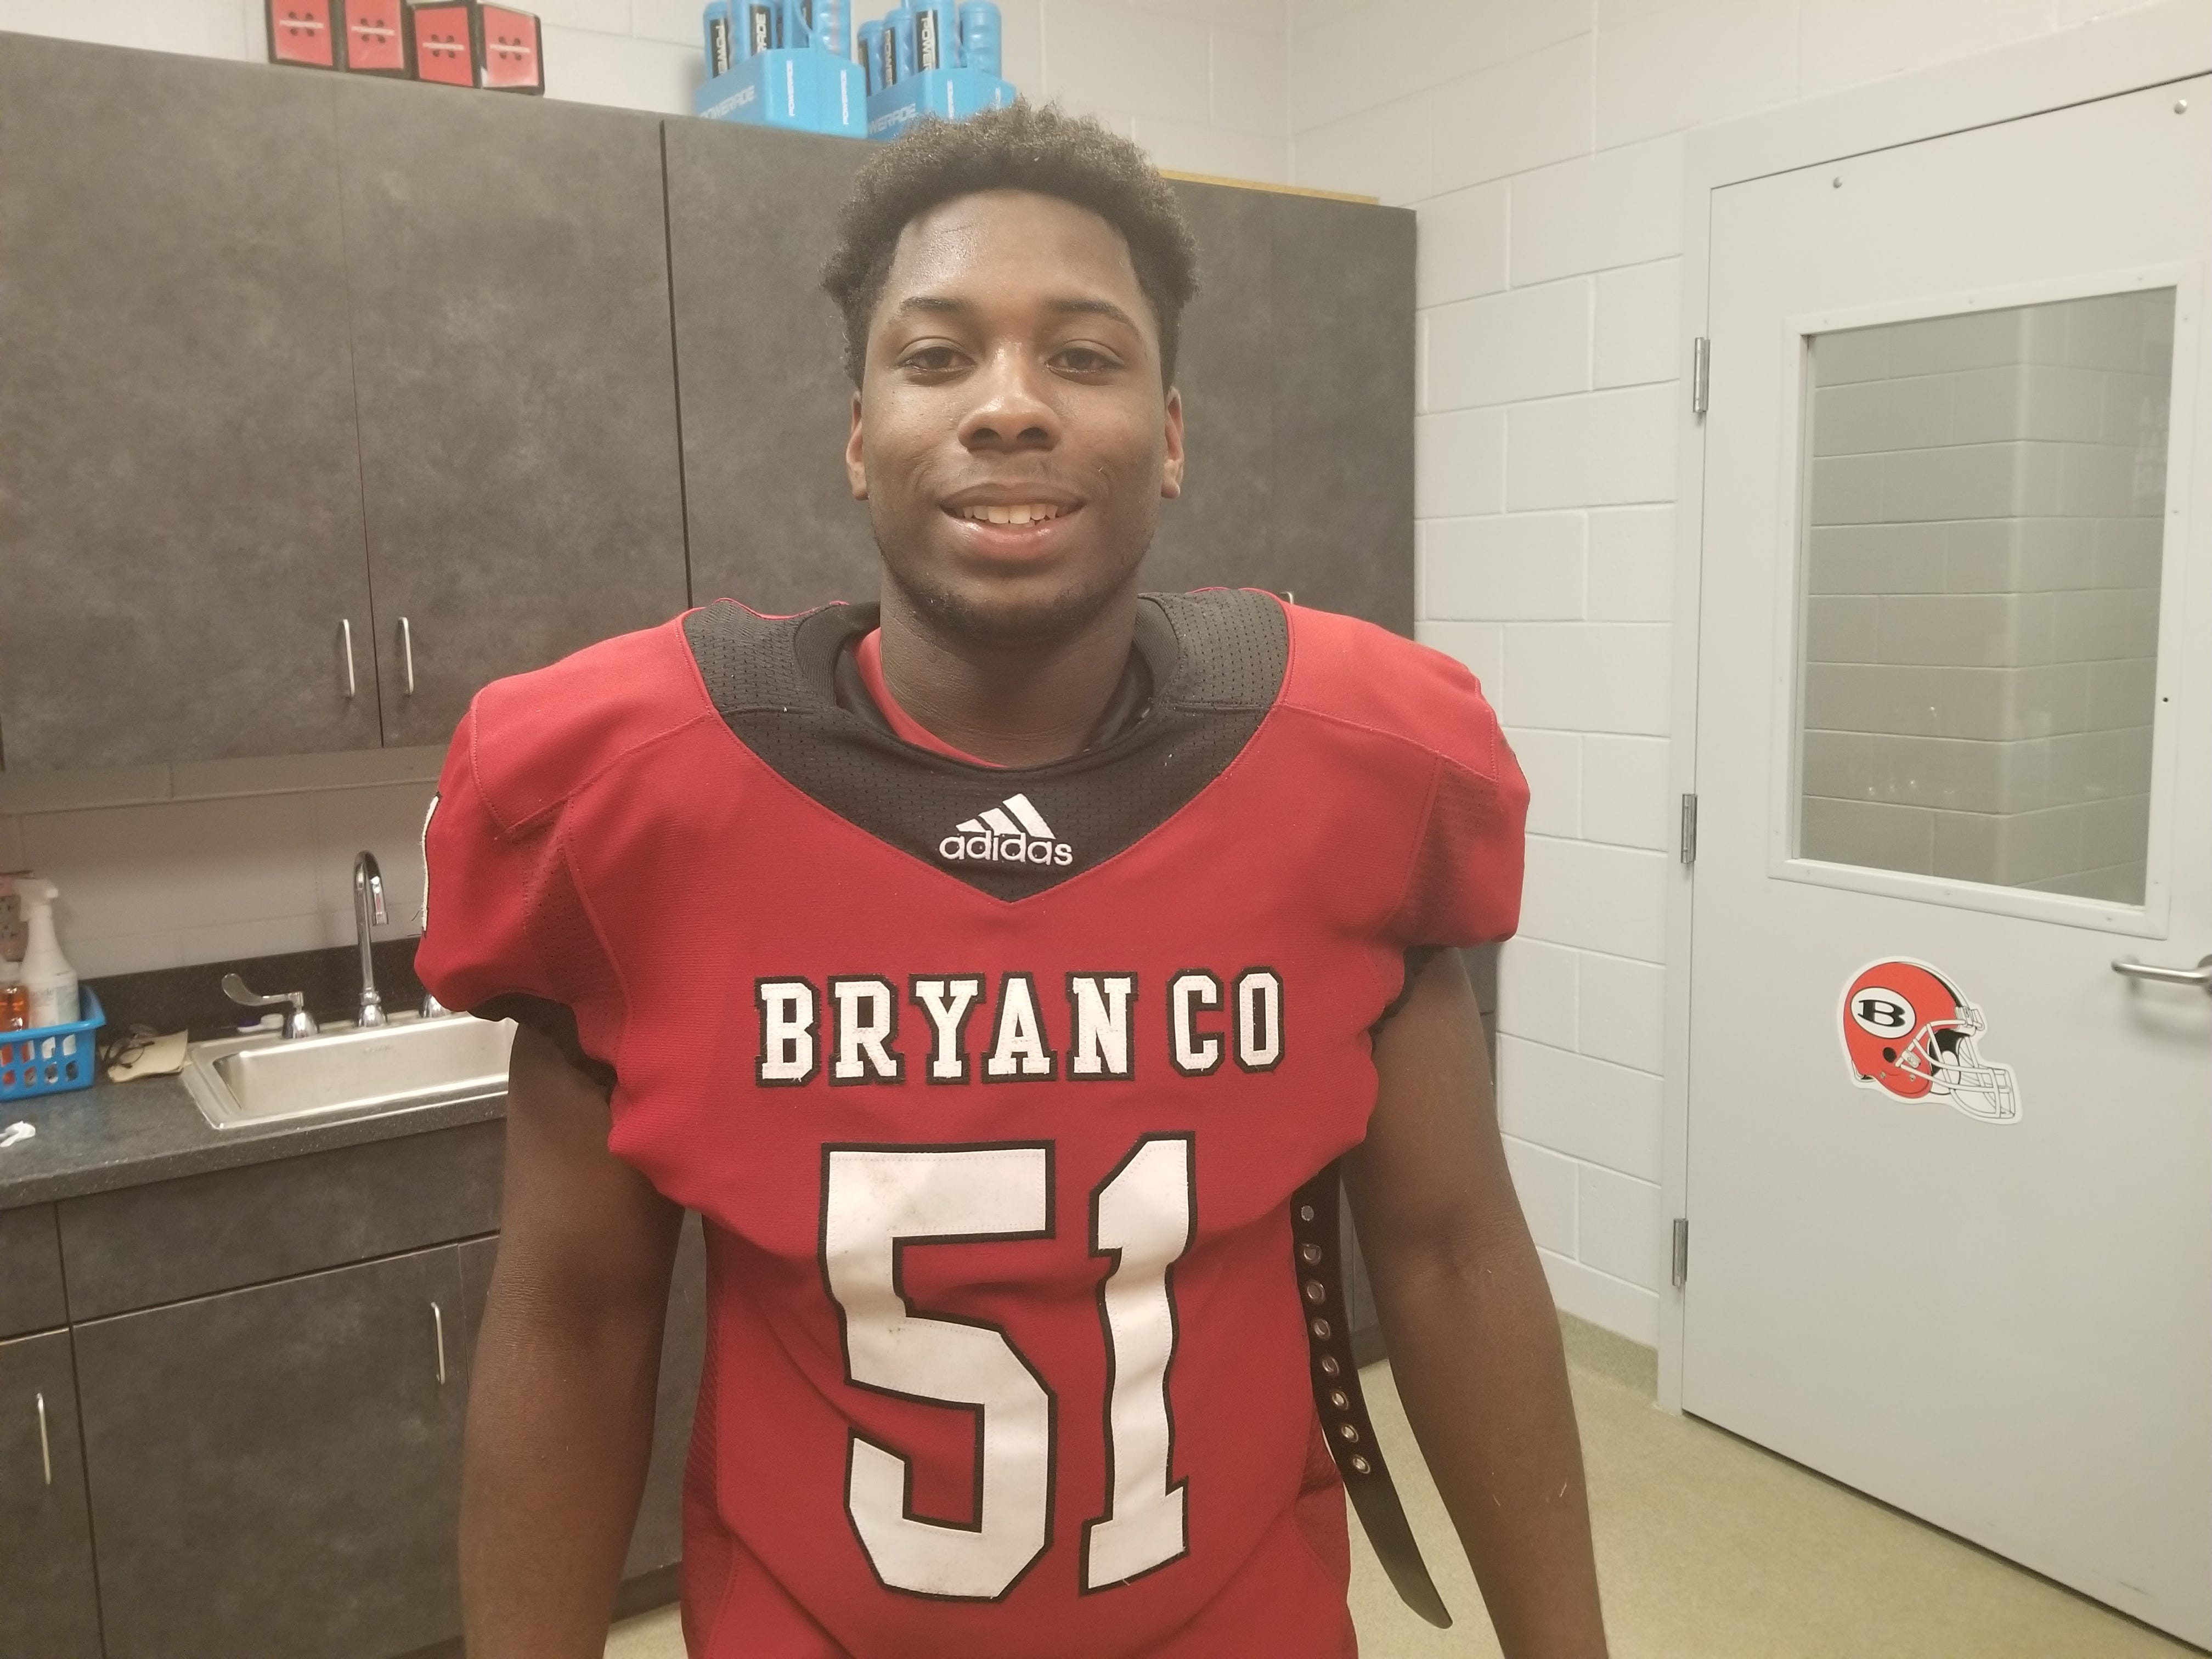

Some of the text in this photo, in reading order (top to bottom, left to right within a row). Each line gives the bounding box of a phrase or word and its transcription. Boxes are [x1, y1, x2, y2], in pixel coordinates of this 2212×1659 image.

[786, 60, 795, 116] POWERADE
[939, 830, 1073, 866] adidas
[756, 966, 1284, 1086] BRYAN CO
[1858, 999, 1905, 1028] B
[819, 1131, 1197, 1602] 51
